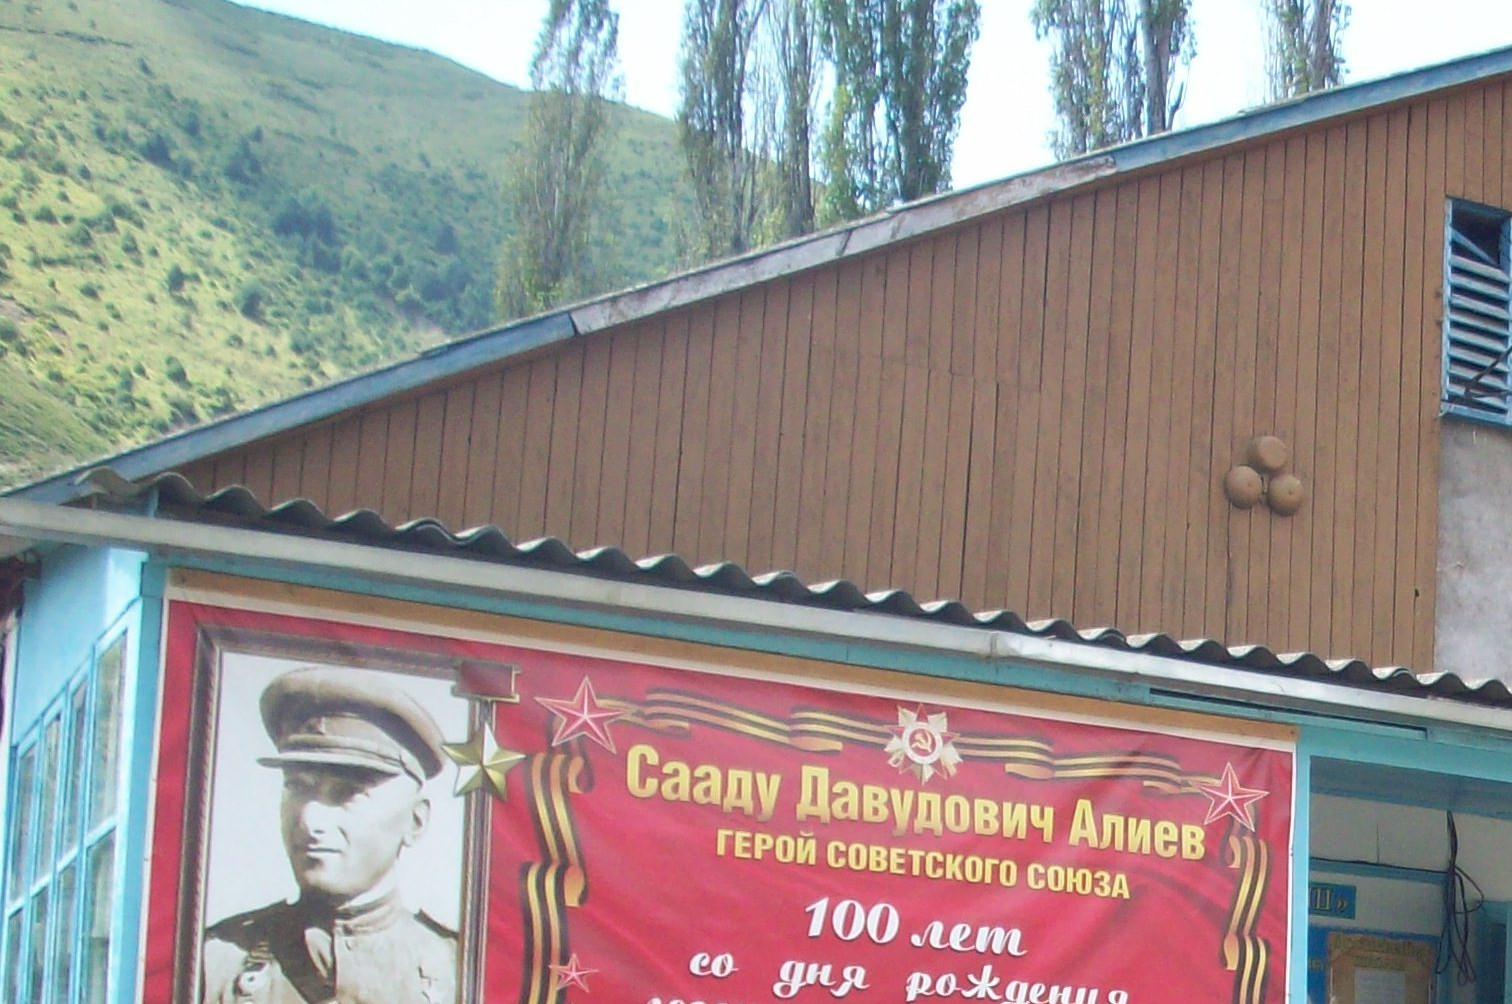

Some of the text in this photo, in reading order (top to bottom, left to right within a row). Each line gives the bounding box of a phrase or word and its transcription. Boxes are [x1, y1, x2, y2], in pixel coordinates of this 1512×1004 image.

[626, 744, 1206, 860] Сааду Давудович Алиев
[716, 829, 1130, 899] ГЕРОЙ СОВЕТСКОГО СОЮЗА
[805, 897, 1027, 956] 100 лет
[689, 953, 738, 977] со
[773, 960, 870, 998] дня
